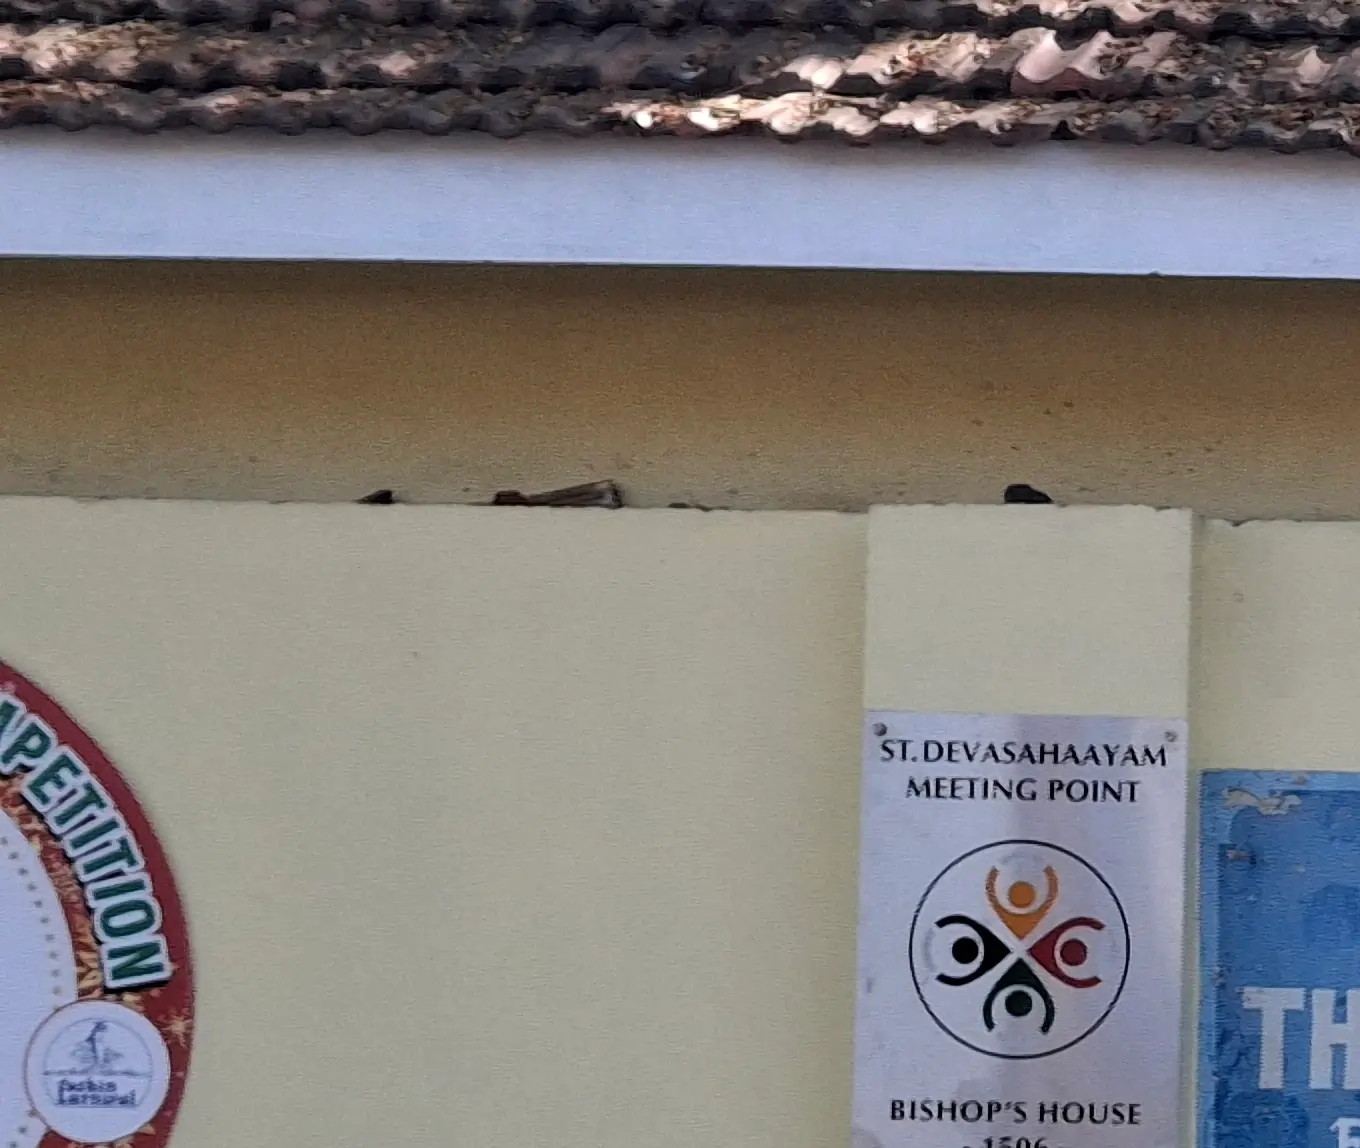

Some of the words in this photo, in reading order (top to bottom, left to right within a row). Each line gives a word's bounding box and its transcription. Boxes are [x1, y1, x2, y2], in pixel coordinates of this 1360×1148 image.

[906, 777, 1037, 800] MEETING
[1048, 779, 1141, 803] POINT
[890, 1099, 1028, 1123] BISHOP'S
[1039, 1101, 1141, 1125] HOUSE
